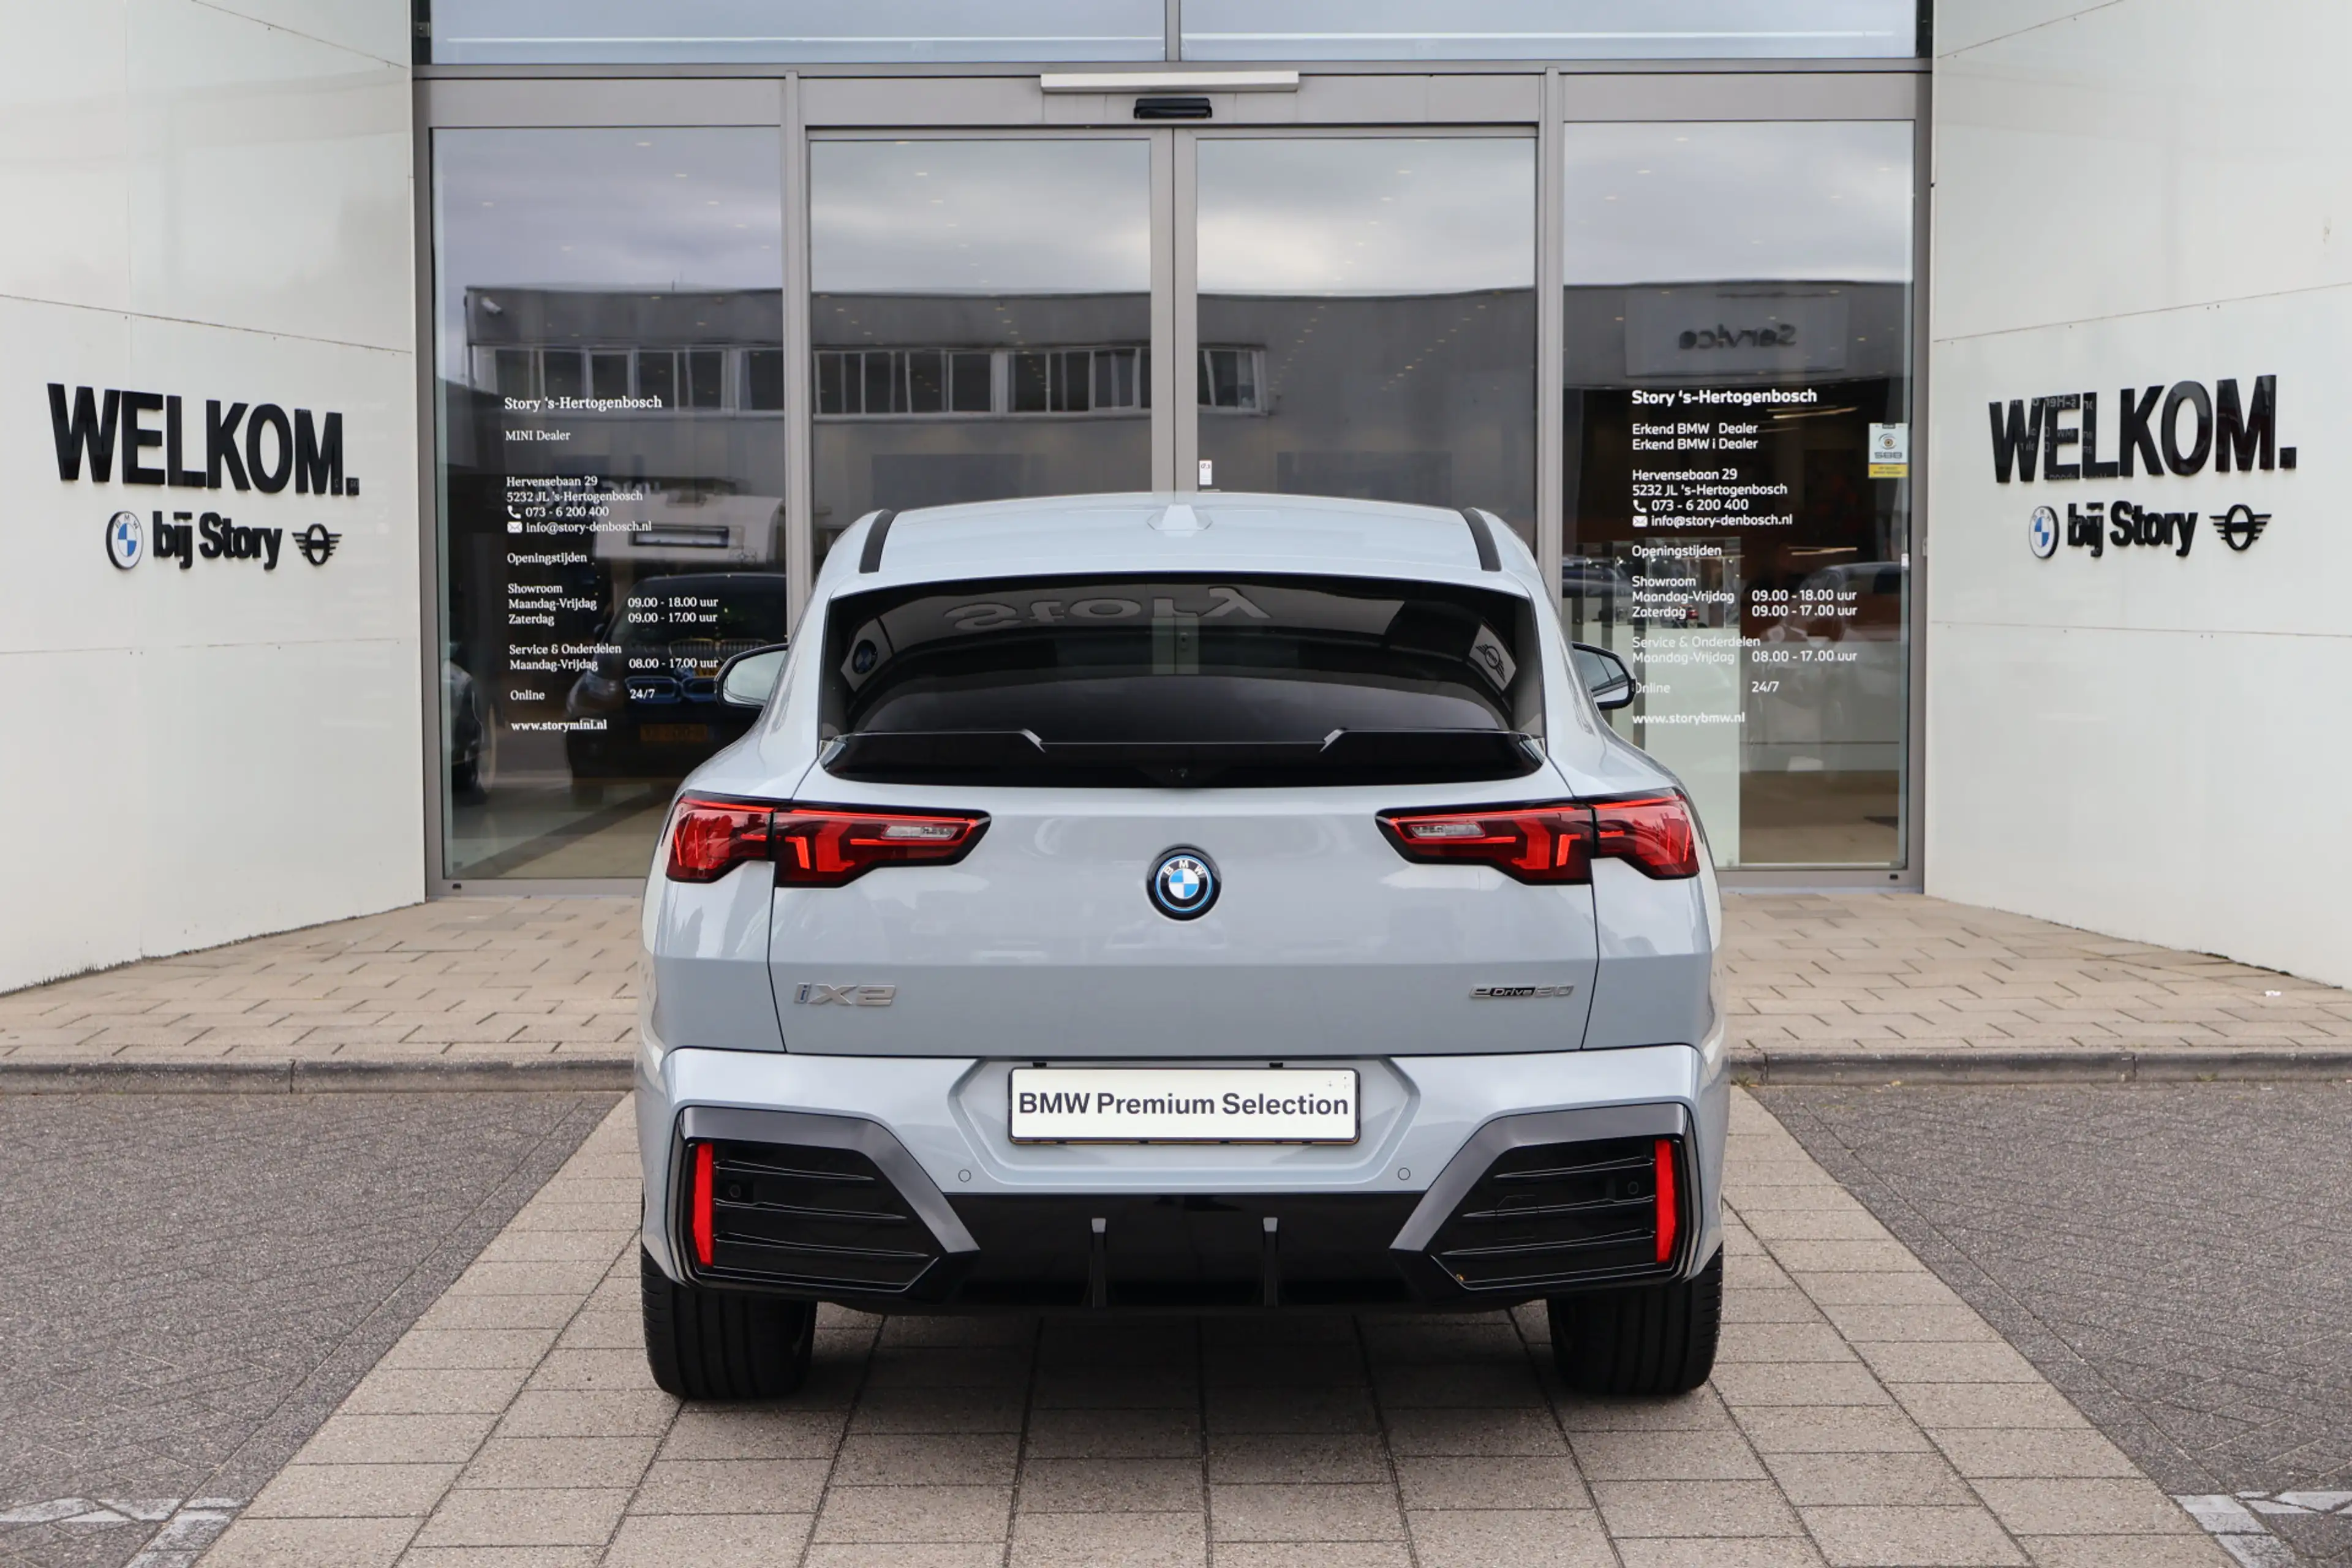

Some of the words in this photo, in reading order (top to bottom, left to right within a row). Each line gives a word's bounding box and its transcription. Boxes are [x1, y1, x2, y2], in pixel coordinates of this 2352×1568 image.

[505, 397, 541, 412] Story
[1632, 390, 1675, 407] Story
[1632, 423, 1674, 435] Erkend
[1678, 423, 1709, 435] BMW
[1719, 422, 1758, 434] Dealer
[1989, 374, 2297, 483] WELKOM.
[47, 383, 360, 496] WELKOM.
[506, 430, 533, 441] MINI
[537, 430, 570, 441] Dealer
[1632, 439, 1674, 450] Erkend
[1678, 438, 1709, 450] BMW
[1713, 438, 1716, 450] i
[1719, 437, 1758, 450] Dealer
[507, 476, 581, 487] Hervensebaan
[584, 475, 598, 486] 29
[1632, 469, 1719, 481] Hervensebaan
[1722, 468, 1738, 480] 29
[507, 492, 533, 502] 5232
[536, 492, 549, 502] JL
[552, 490, 643, 503] 's-Hertogenbosch
[1632, 484, 1662, 496] 5232
[1664, 484, 1678, 497] JL
[1681, 483, 1787, 498] 's-Hertogenbosch
[1651, 500, 1674, 511] 073
[1686, 499, 1694, 511] 6
[1697, 499, 1721, 511] 200
[1724, 498, 1749, 510] 400
[526, 507, 546, 518] 073
[556, 507, 563, 517] 6
[566, 507, 586, 517] 200
[589, 506, 609, 516] 400
[1651, 513, 1793, 529] info@story-denbosch.nl
[526, 521, 652, 535] info@story-denbosch.nl
[2067, 502, 2103, 557] bij
[2109, 500, 2198, 557] Story
[153, 510, 193, 570] bij
[199, 512, 282, 570] Story
[507, 552, 587, 564] Openingstijden
[1632, 545, 1722, 558] Openingstijden
[1632, 575, 1696, 587] Showroom
[508, 583, 563, 594] Showroom
[1632, 590, 1735, 604] Maandag-Vrijdag
[1752, 589, 1789, 601] 09.00
[1800, 589, 1834, 601] 18.00
[1837, 592, 1857, 601] uur
[508, 598, 597, 611] Maandag-Vrijdag
[628, 597, 658, 608] 09.00
[669, 597, 698, 608] 18.00
[699, 599, 718, 608] uur
[1632, 606, 1686, 619] Zaterdag
[1752, 605, 1789, 617] 09.00
[1838, 606, 1858, 616] uur
[508, 613, 554, 627] Zaterdag
[628, 612, 658, 624] 09.00
[669, 612, 696, 623] 17.00
[699, 614, 718, 623] uur
[1632, 636, 1676, 648] Service
[1679, 636, 1687, 647] &
[1692, 636, 1761, 647] Onderdelen
[509, 644, 548, 655] Service
[551, 644, 558, 655] &
[561, 643, 622, 655] Onderdelen
[1632, 652, 1735, 665] Maandag-Vrijdag
[1752, 650, 1789, 662] 08.00
[1838, 653, 1858, 662] uur
[510, 659, 598, 672] Maandag-Vrijdag
[628, 658, 659, 669] 08.00
[669, 658, 698, 669] 17.00
[699, 660, 718, 668] uur
[1752, 681, 1779, 693] 24/7
[510, 689, 545, 701] Online
[630, 688, 655, 699] 24/7
[1632, 712, 1745, 725] www.storybmw.nl
[511, 719, 608, 732] www.storymini.nl
[794, 982, 895, 1006] iX2
[1019, 1093, 1090, 1114] BMW
[1097, 1093, 1215, 1114] Premium
[1222, 1092, 1349, 1115] Selection
